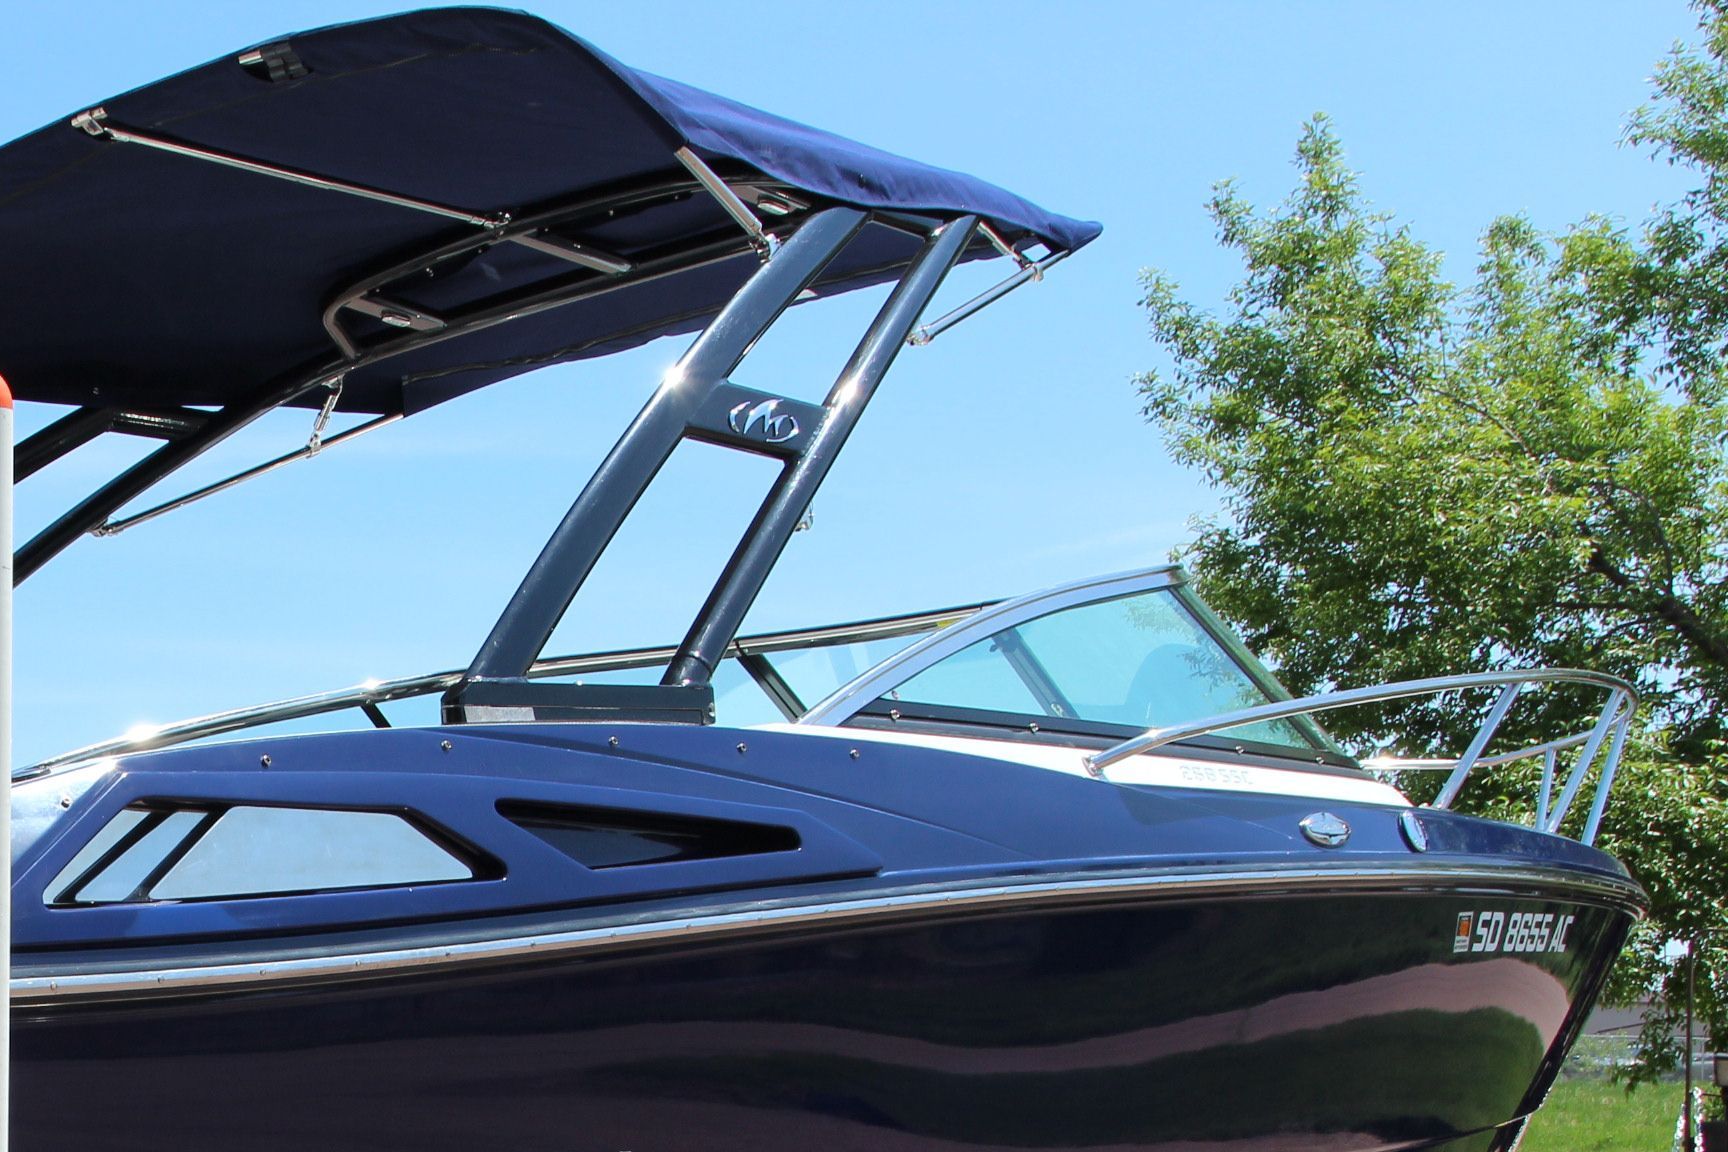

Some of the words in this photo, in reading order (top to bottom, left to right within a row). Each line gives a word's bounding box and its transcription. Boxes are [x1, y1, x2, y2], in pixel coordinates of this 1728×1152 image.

[1471, 911, 1505, 953] SD
[1503, 912, 1554, 953] 8655
[1547, 914, 1575, 953] AC
